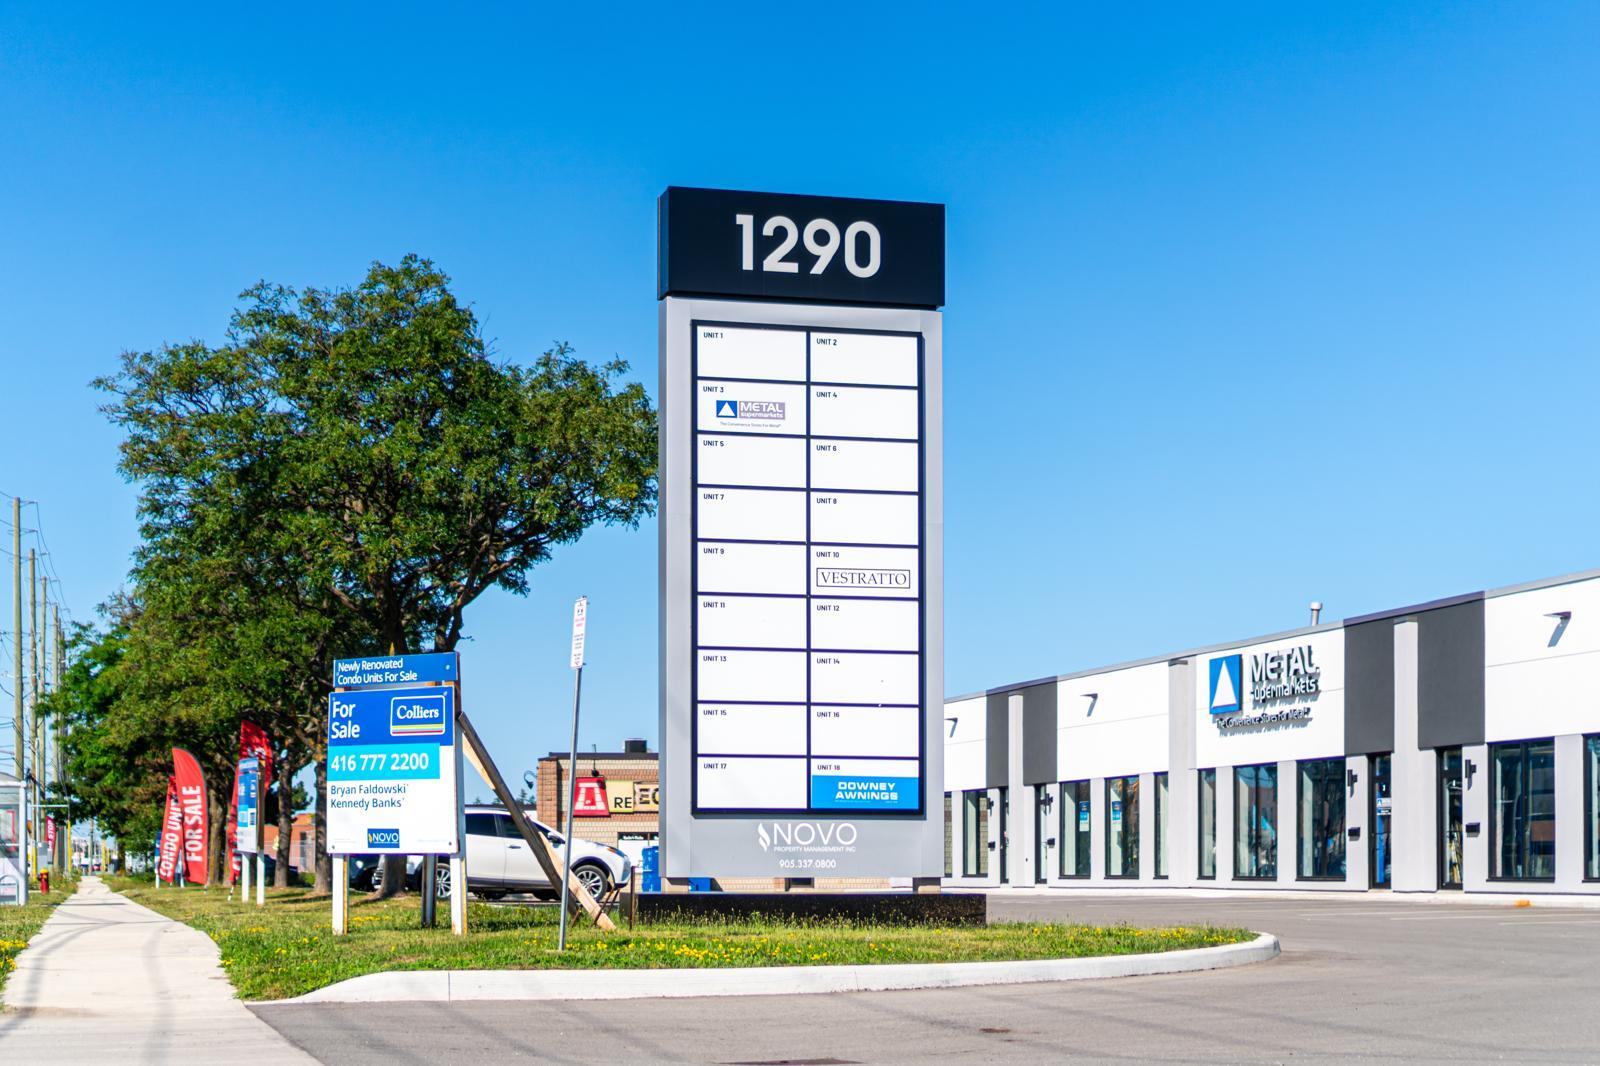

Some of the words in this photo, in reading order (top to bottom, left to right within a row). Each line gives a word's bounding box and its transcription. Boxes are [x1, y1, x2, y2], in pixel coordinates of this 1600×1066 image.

[736, 214, 881, 278] 1290
[833, 338, 838, 346] 2
[741, 402, 784, 412] METAL
[741, 411, 784, 419] supermarkets
[820, 571, 907, 586] VESTRATTO
[338, 662, 361, 673] Newly
[361, 658, 403, 671] Renovated
[1250, 645, 1317, 682] METAL
[337, 674, 362, 685] Condo
[363, 673, 383, 683] Units
[385, 672, 398, 682] For
[400, 670, 418, 681] Sale
[332, 701, 356, 718] For
[396, 705, 439, 719] Colliers
[331, 720, 360, 739] Sale
[331, 755, 356, 772] 416
[360, 754, 387, 771] 777
[390, 753, 429, 770] 2200
[330, 785, 356, 797] Bryan
[838, 781, 896, 791] DOWNEY
[614, 797, 633, 809] RE
[835, 791, 898, 801] AWNINGS
[182, 785, 203, 826] SALE
[330, 798, 369, 811] Kennedy
[373, 832, 398, 842] NOVO
[774, 823, 857, 845] NOVO
[185, 828, 203, 862] FOR
[160, 832, 179, 877] CONDO
